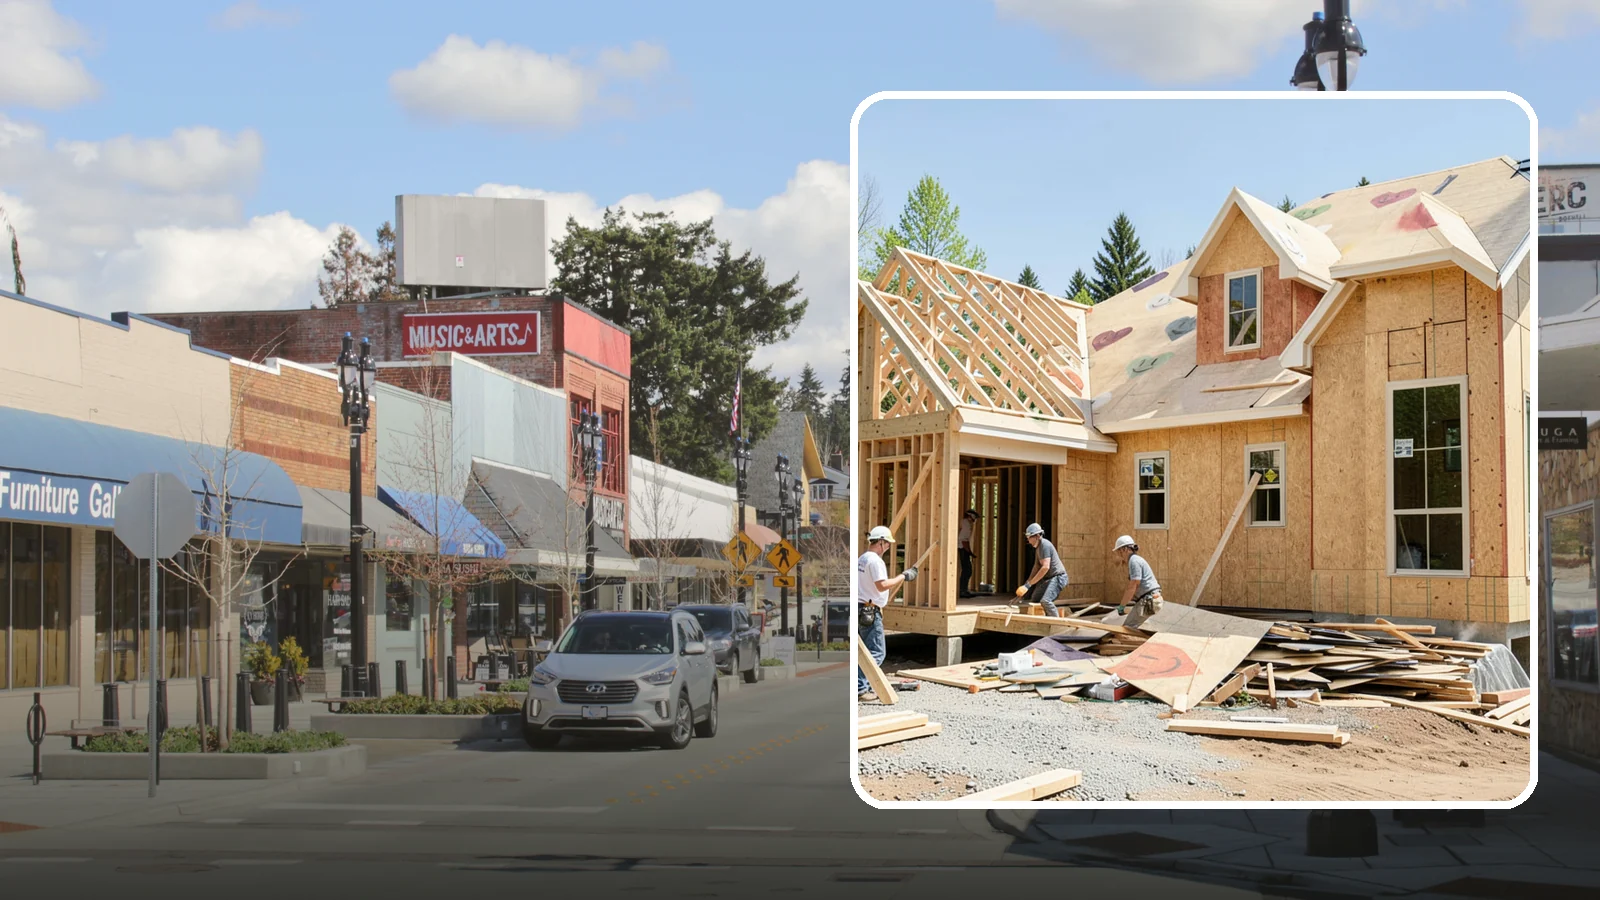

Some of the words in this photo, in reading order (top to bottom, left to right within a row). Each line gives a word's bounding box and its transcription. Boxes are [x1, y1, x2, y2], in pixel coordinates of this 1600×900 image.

[409, 323, 520, 349] MUSIC&ARTS
[0, 471, 79, 515] Furniture
[89, 482, 122, 519] Gal
